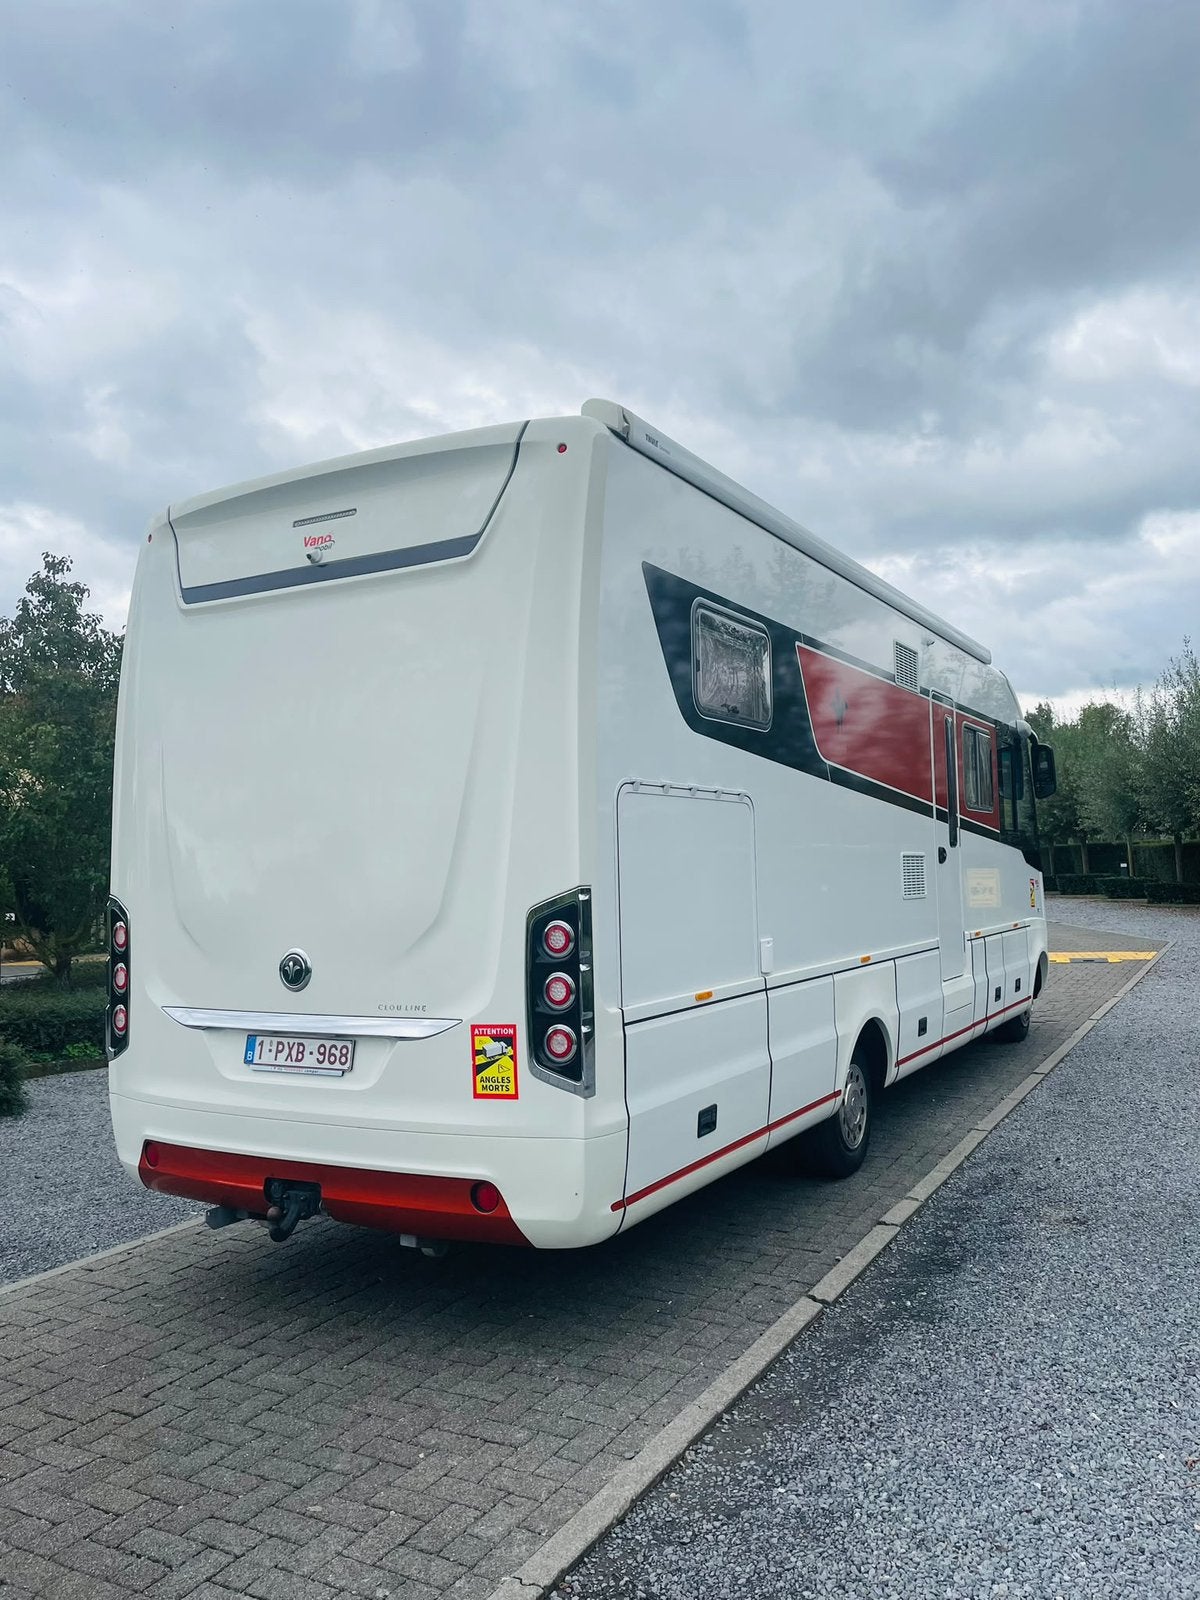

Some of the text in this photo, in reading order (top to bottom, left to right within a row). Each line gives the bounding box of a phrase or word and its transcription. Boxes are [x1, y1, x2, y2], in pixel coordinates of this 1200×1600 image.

[304, 534, 332, 547] Vano
[405, 1004, 427, 1012] LINE
[247, 1051, 253, 1060] B
[480, 1076, 511, 1084] ANGLES
[481, 1084, 510, 1092] MORTS
